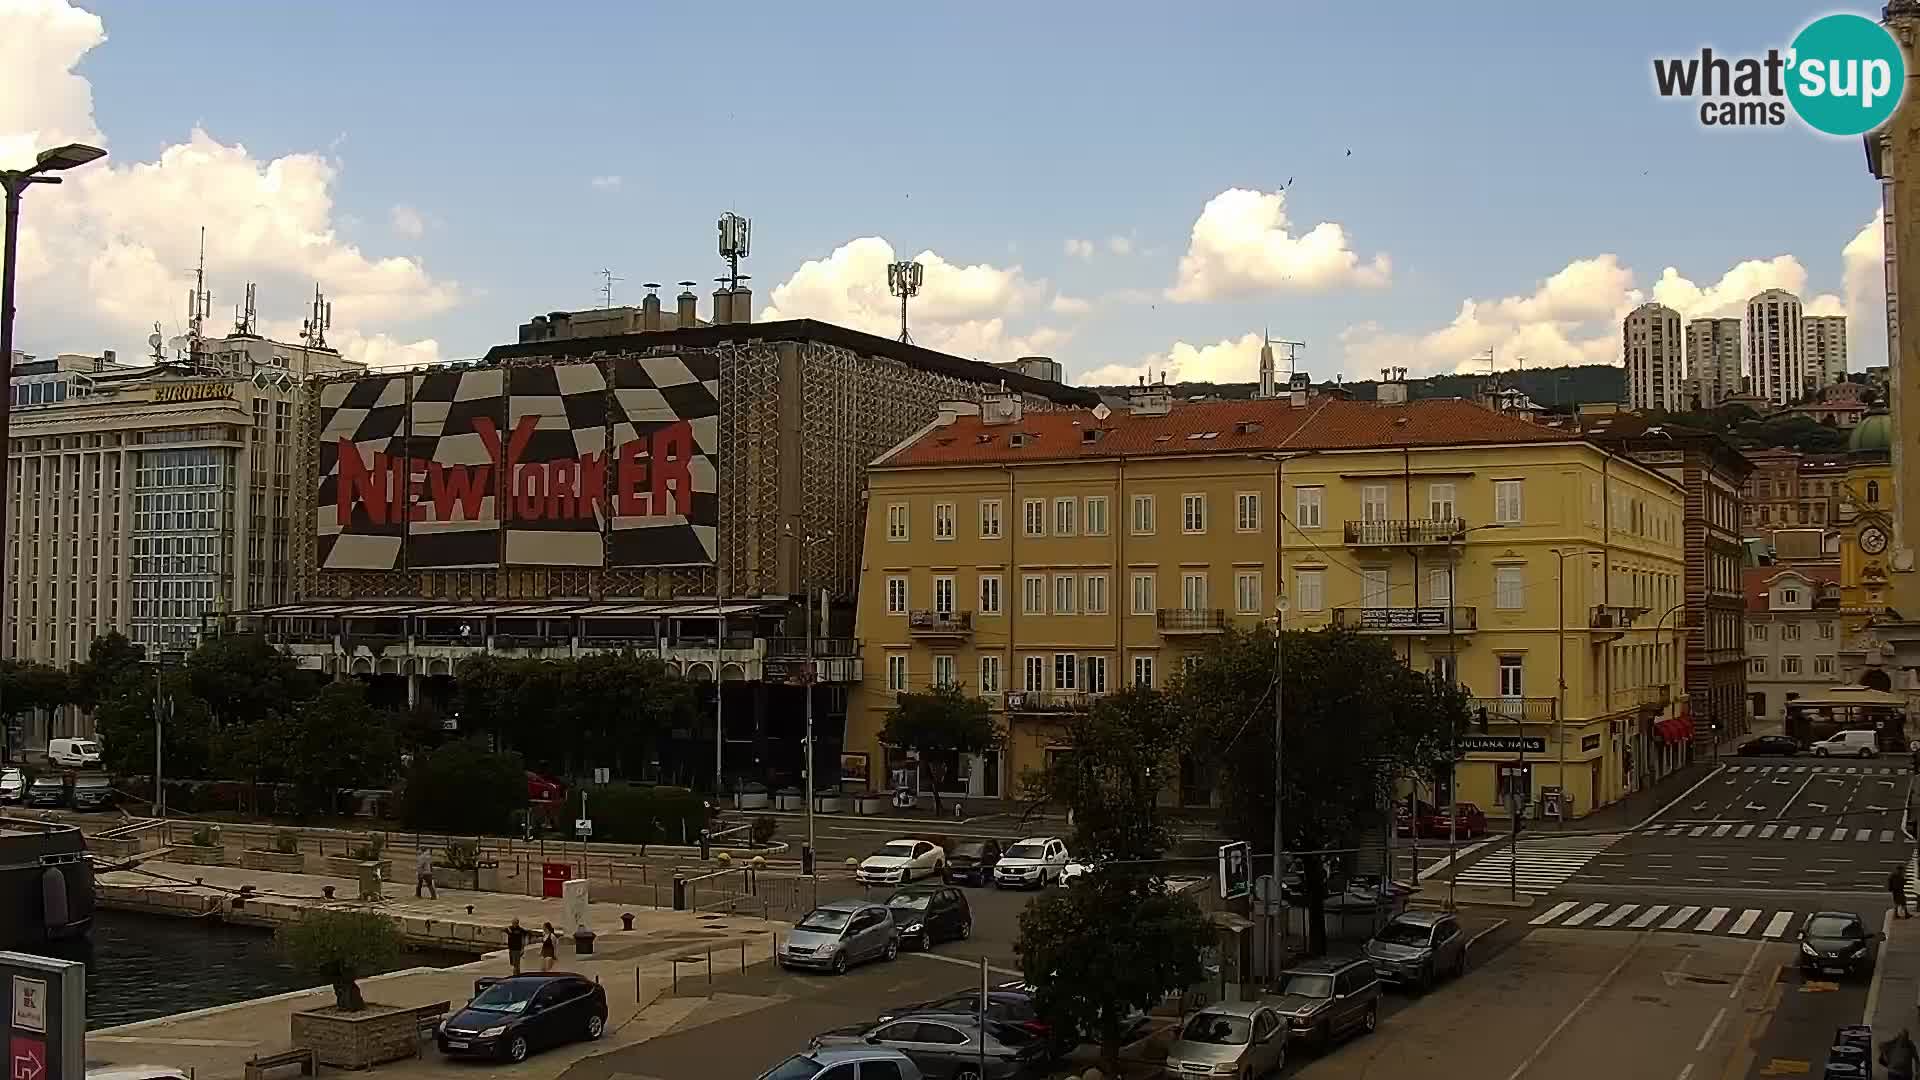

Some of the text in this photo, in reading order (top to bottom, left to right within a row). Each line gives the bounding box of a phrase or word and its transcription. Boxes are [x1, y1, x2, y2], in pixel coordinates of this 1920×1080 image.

[337, 414, 694, 526] NEW YORKER
[1458, 740, 1540, 749] JULIANA NAILS
